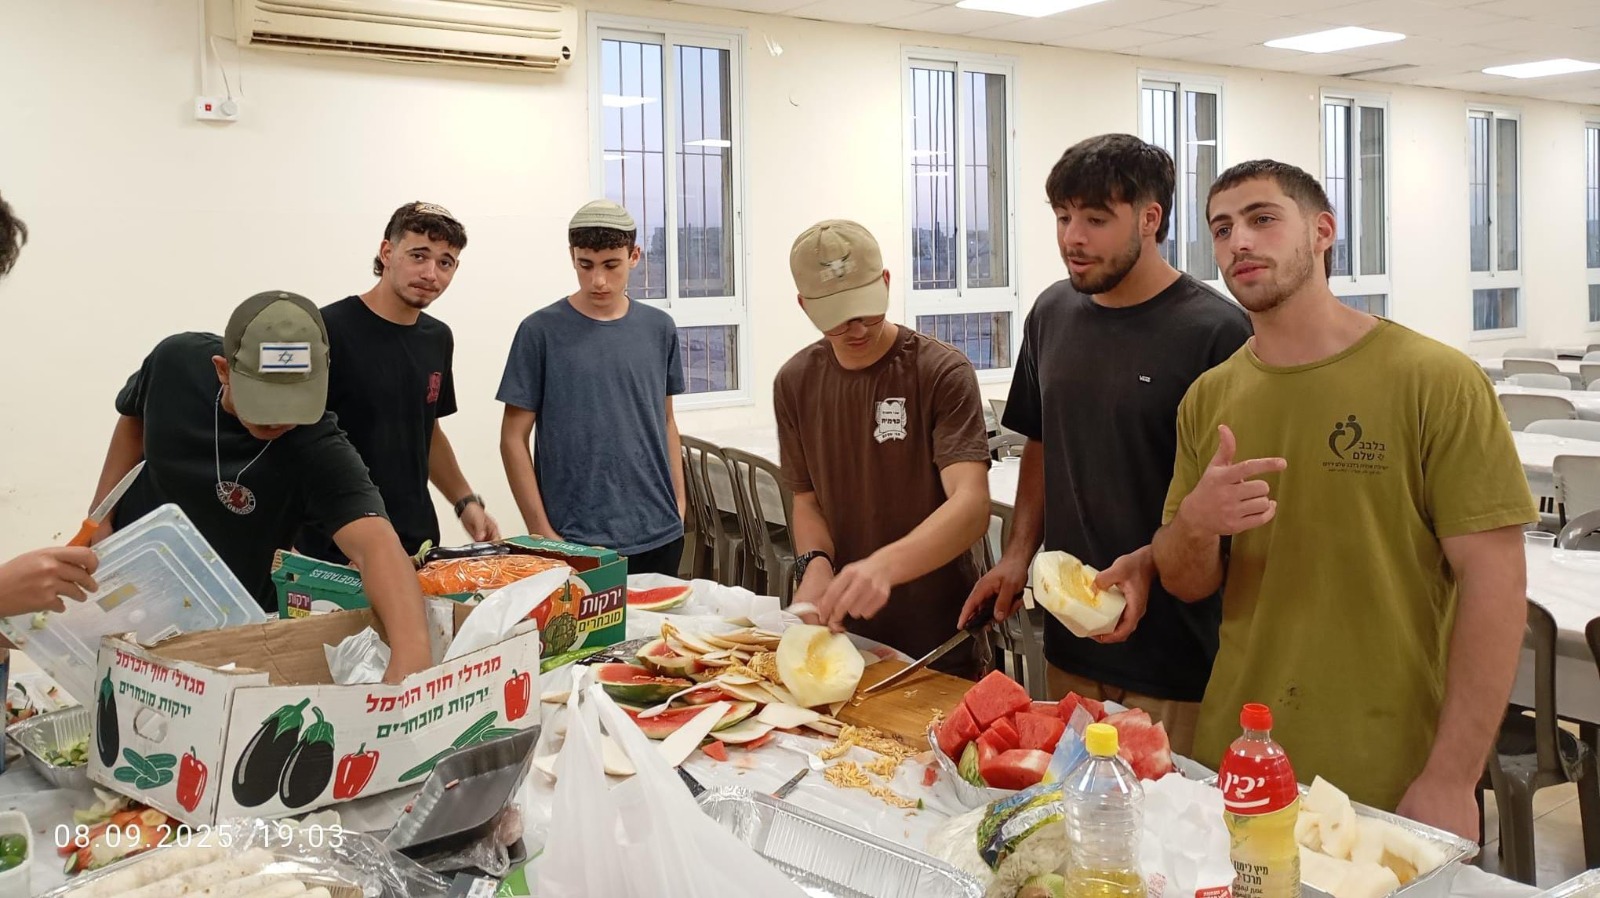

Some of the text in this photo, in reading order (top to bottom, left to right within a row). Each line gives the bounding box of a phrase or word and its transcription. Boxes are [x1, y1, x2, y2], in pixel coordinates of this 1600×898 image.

[1352, 450, 1375, 460] שלם
[1358, 441, 1385, 451] בלבב
[309, 568, 363, 589] VEGETABLES
[287, 592, 310, 609] ירקות
[581, 588, 622, 616] ירקות
[578, 611, 621, 632] מובחרים
[115, 647, 205, 696] מגדלי חוף הכרמל
[457, 655, 501, 686] מגדלי
[426, 673, 454, 700] חוף
[119, 680, 192, 719] ירקות מובחרים
[376, 687, 489, 739] ירקות מובחרים
[1253, 864, 1269, 876] מיץ
